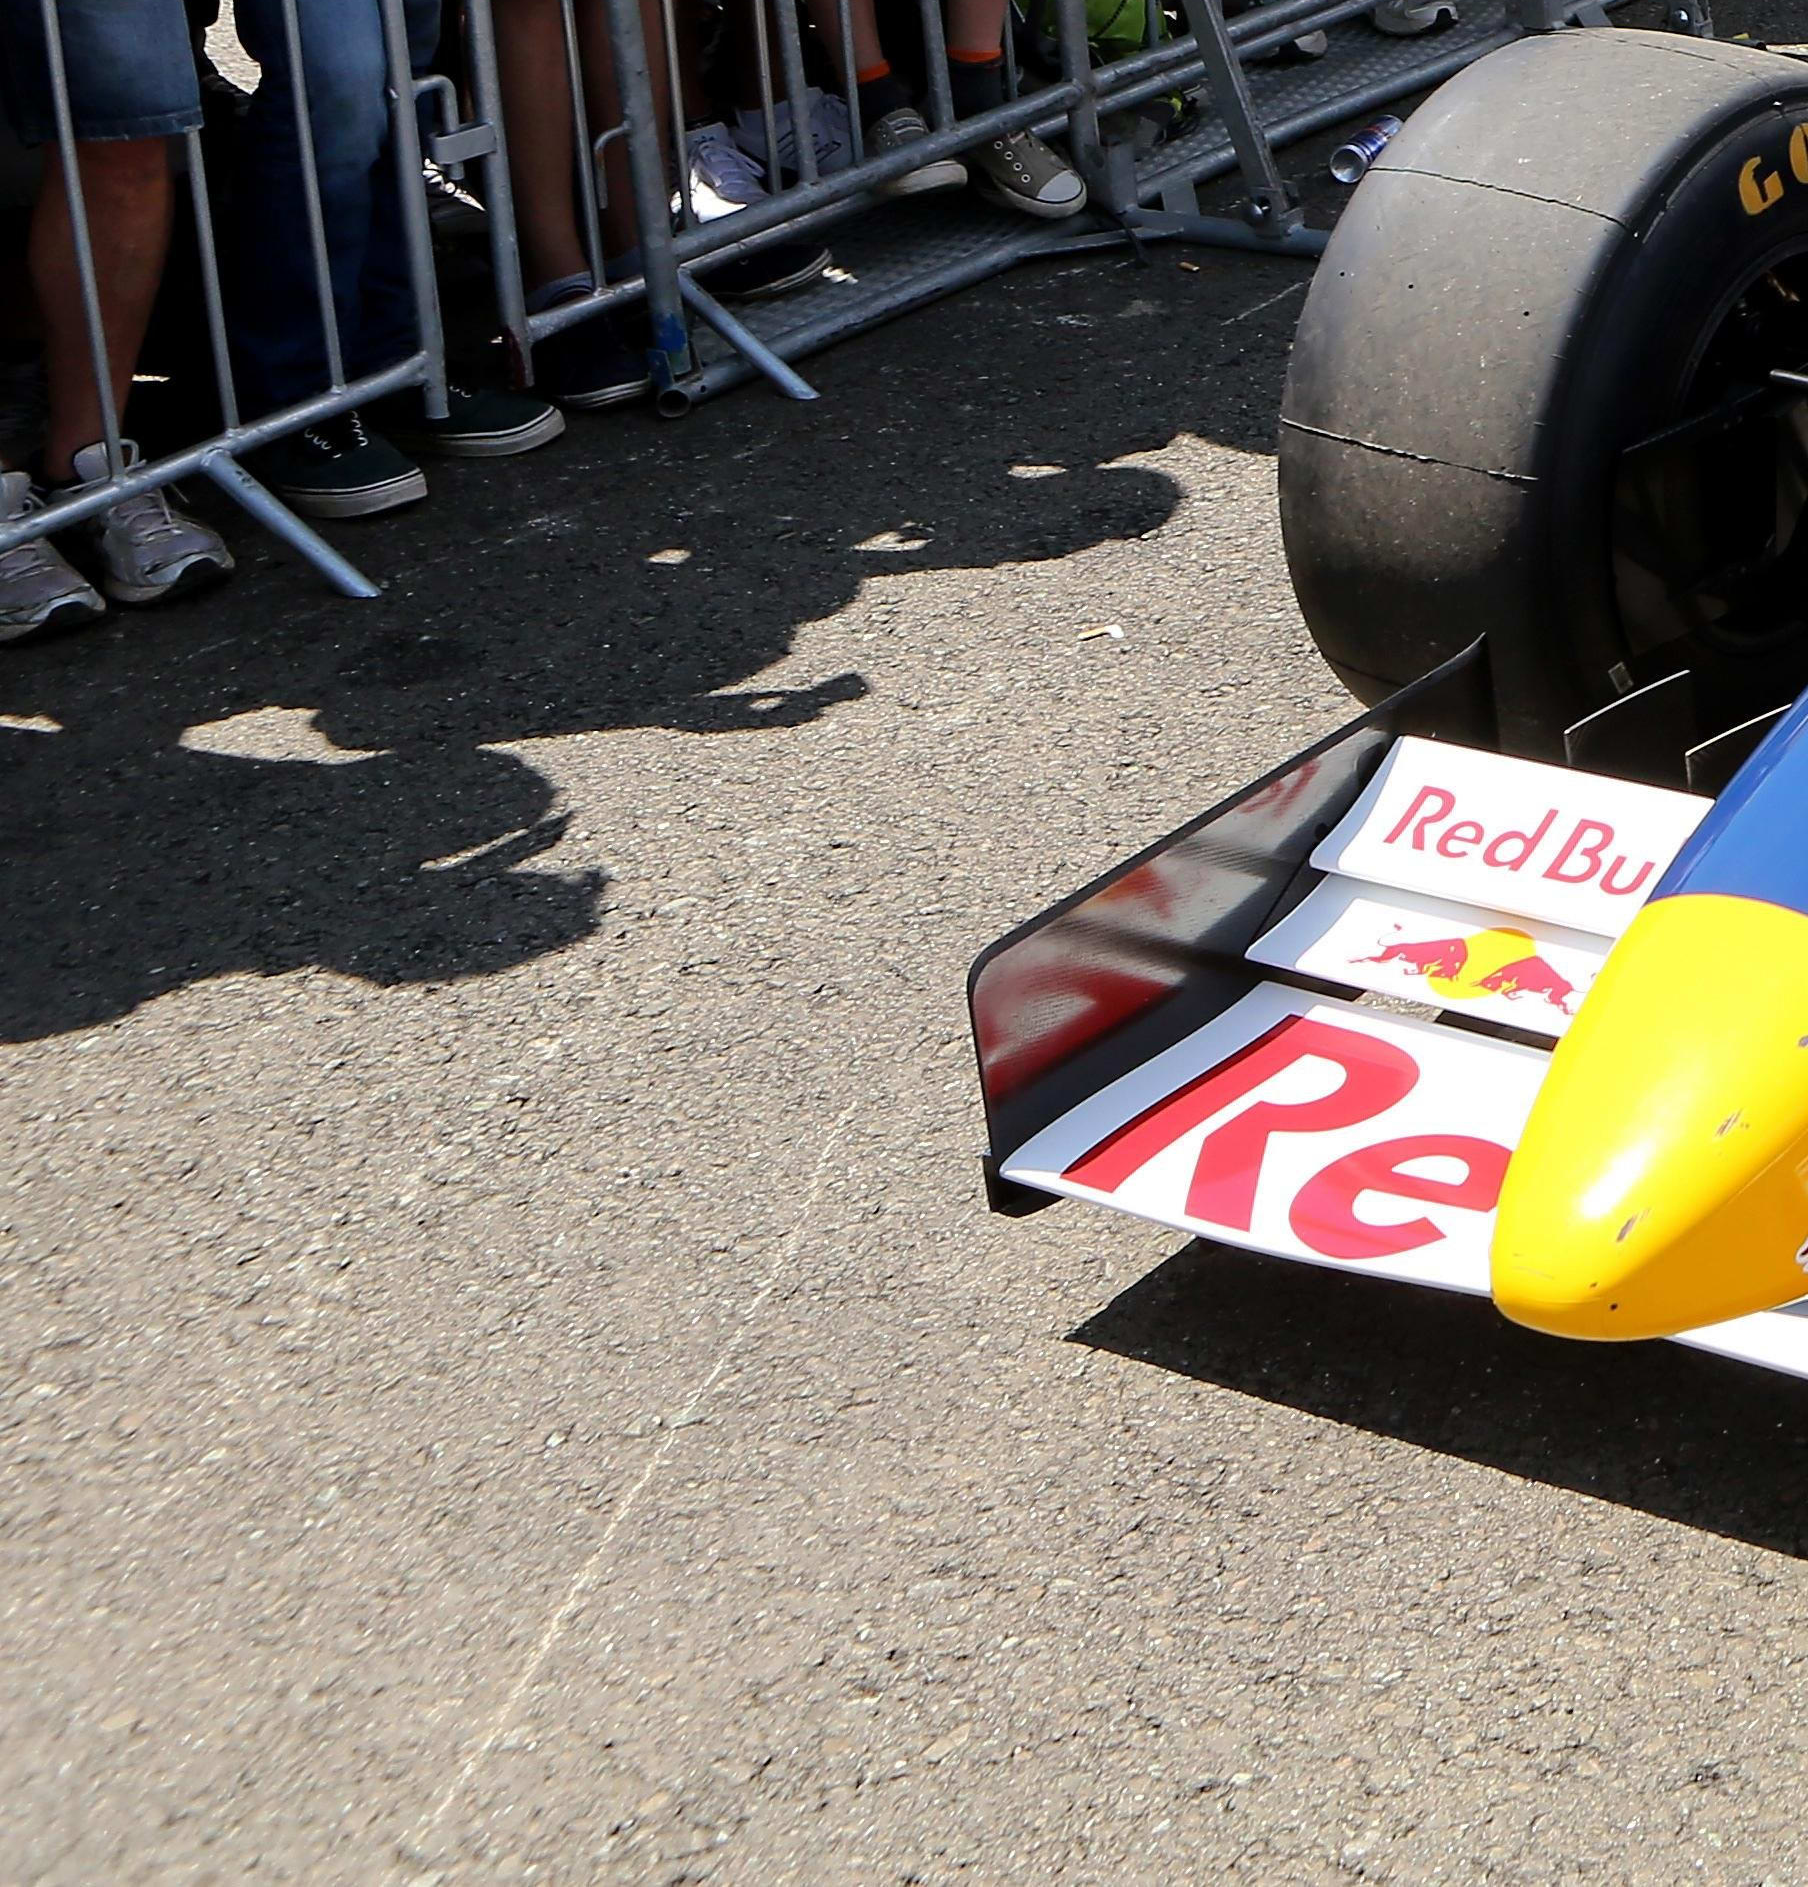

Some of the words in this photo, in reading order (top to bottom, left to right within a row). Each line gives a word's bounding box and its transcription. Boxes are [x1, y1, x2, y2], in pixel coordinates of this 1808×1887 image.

[1384, 785, 1559, 872] Red
[1542, 818, 1656, 895] Bu
[1060, 1013, 1510, 1262] Re
